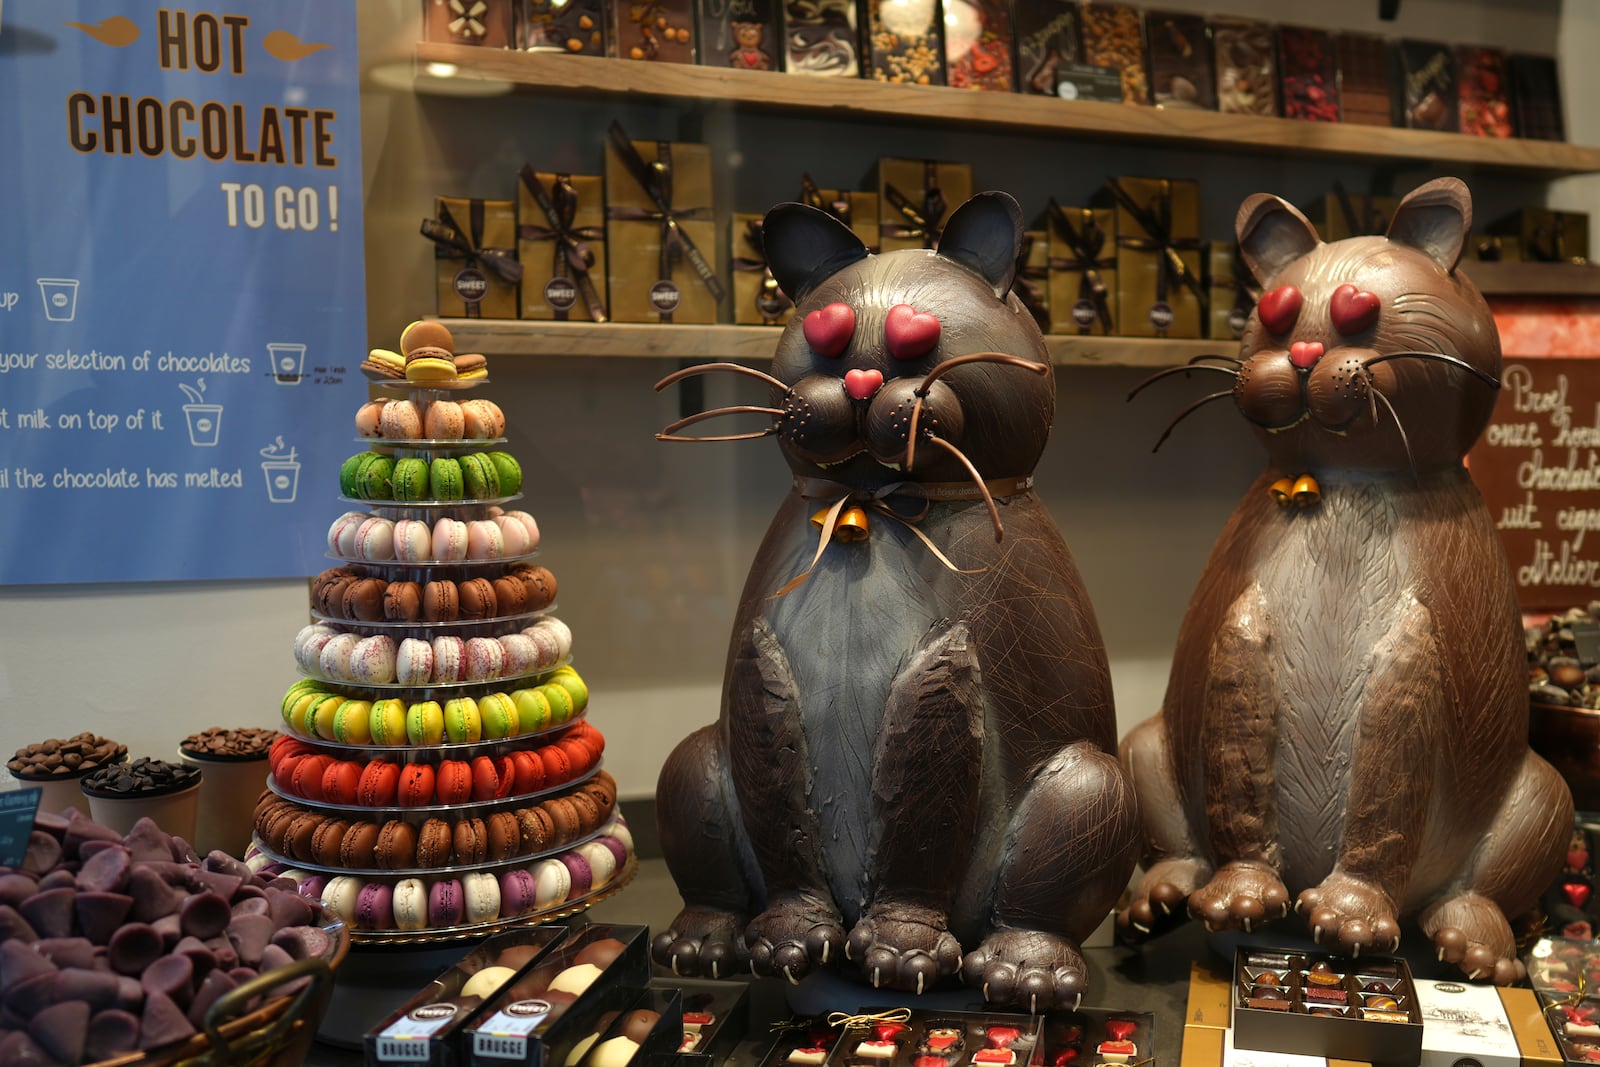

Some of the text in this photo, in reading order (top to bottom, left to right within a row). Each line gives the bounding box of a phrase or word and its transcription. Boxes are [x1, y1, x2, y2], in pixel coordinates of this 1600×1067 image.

[157, 8, 250, 76] HOT
[66, 90, 339, 168] CHOCOLATE
[220, 182, 266, 229] TO
[0, 349, 251, 373] your selection of chocolates
[18, 408, 51, 429] milk
[58, 413, 82, 429] on
[88, 409, 119, 433] top
[125, 408, 146, 430] of
[151, 409, 165, 430] it
[14, 466, 47, 489] the
[52, 466, 140, 489] chocolate
[146, 467, 178, 489] has
[185, 467, 243, 489] melted
[382, 1042, 426, 1057] BRUGGE
[479, 1038, 523, 1056] BRUGGE
